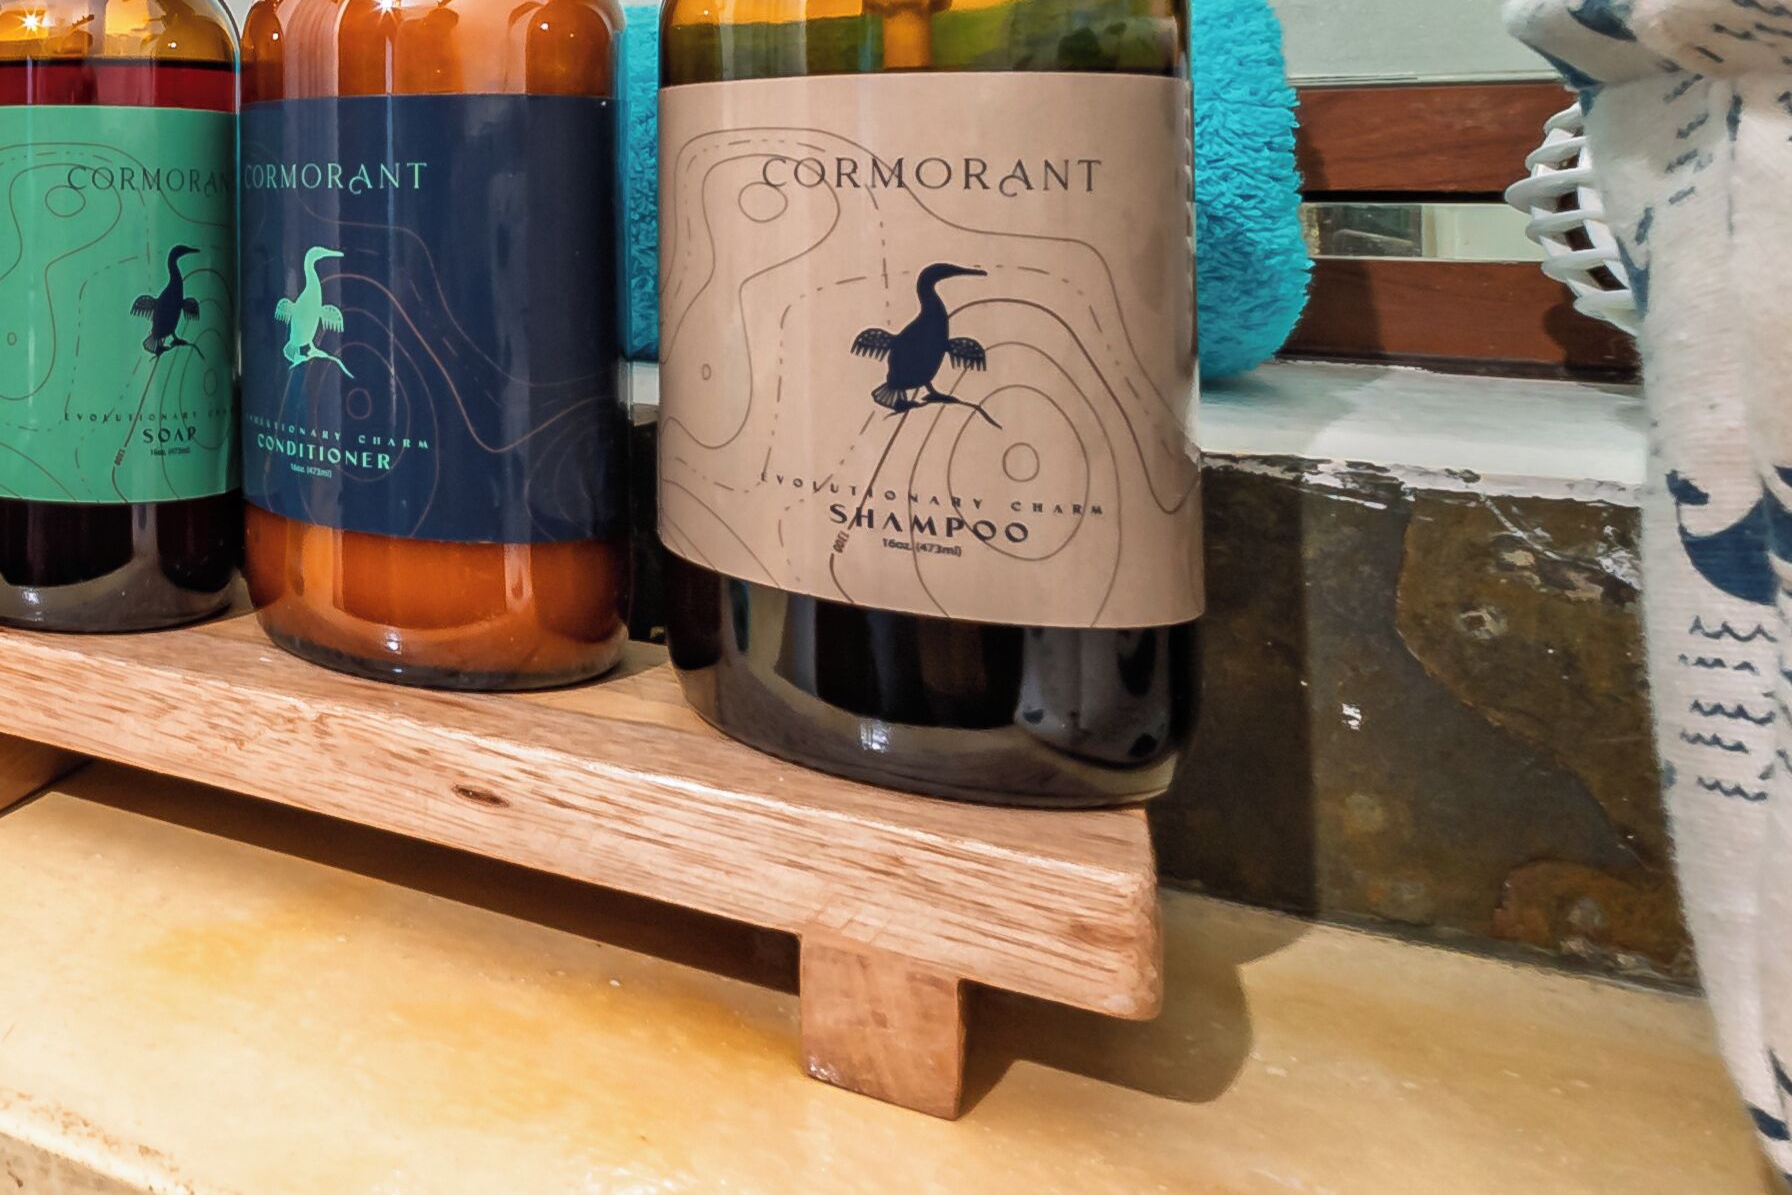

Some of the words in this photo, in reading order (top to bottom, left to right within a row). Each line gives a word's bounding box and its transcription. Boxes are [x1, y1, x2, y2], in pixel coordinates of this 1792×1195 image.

[67, 165, 230, 198] CORMORAN
[244, 162, 428, 195] CORMORANT
[761, 156, 1103, 198] CORMORANT
[142, 426, 197, 444] SOAP
[246, 413, 342, 441] OLUTIONARY
[358, 434, 430, 449] CHARM
[257, 433, 391, 470] CONDITIONER
[760, 471, 983, 510] EVOLUTIONARY
[1010, 500, 1103, 515] CHARM
[829, 503, 1029, 543] SHAMPOO
